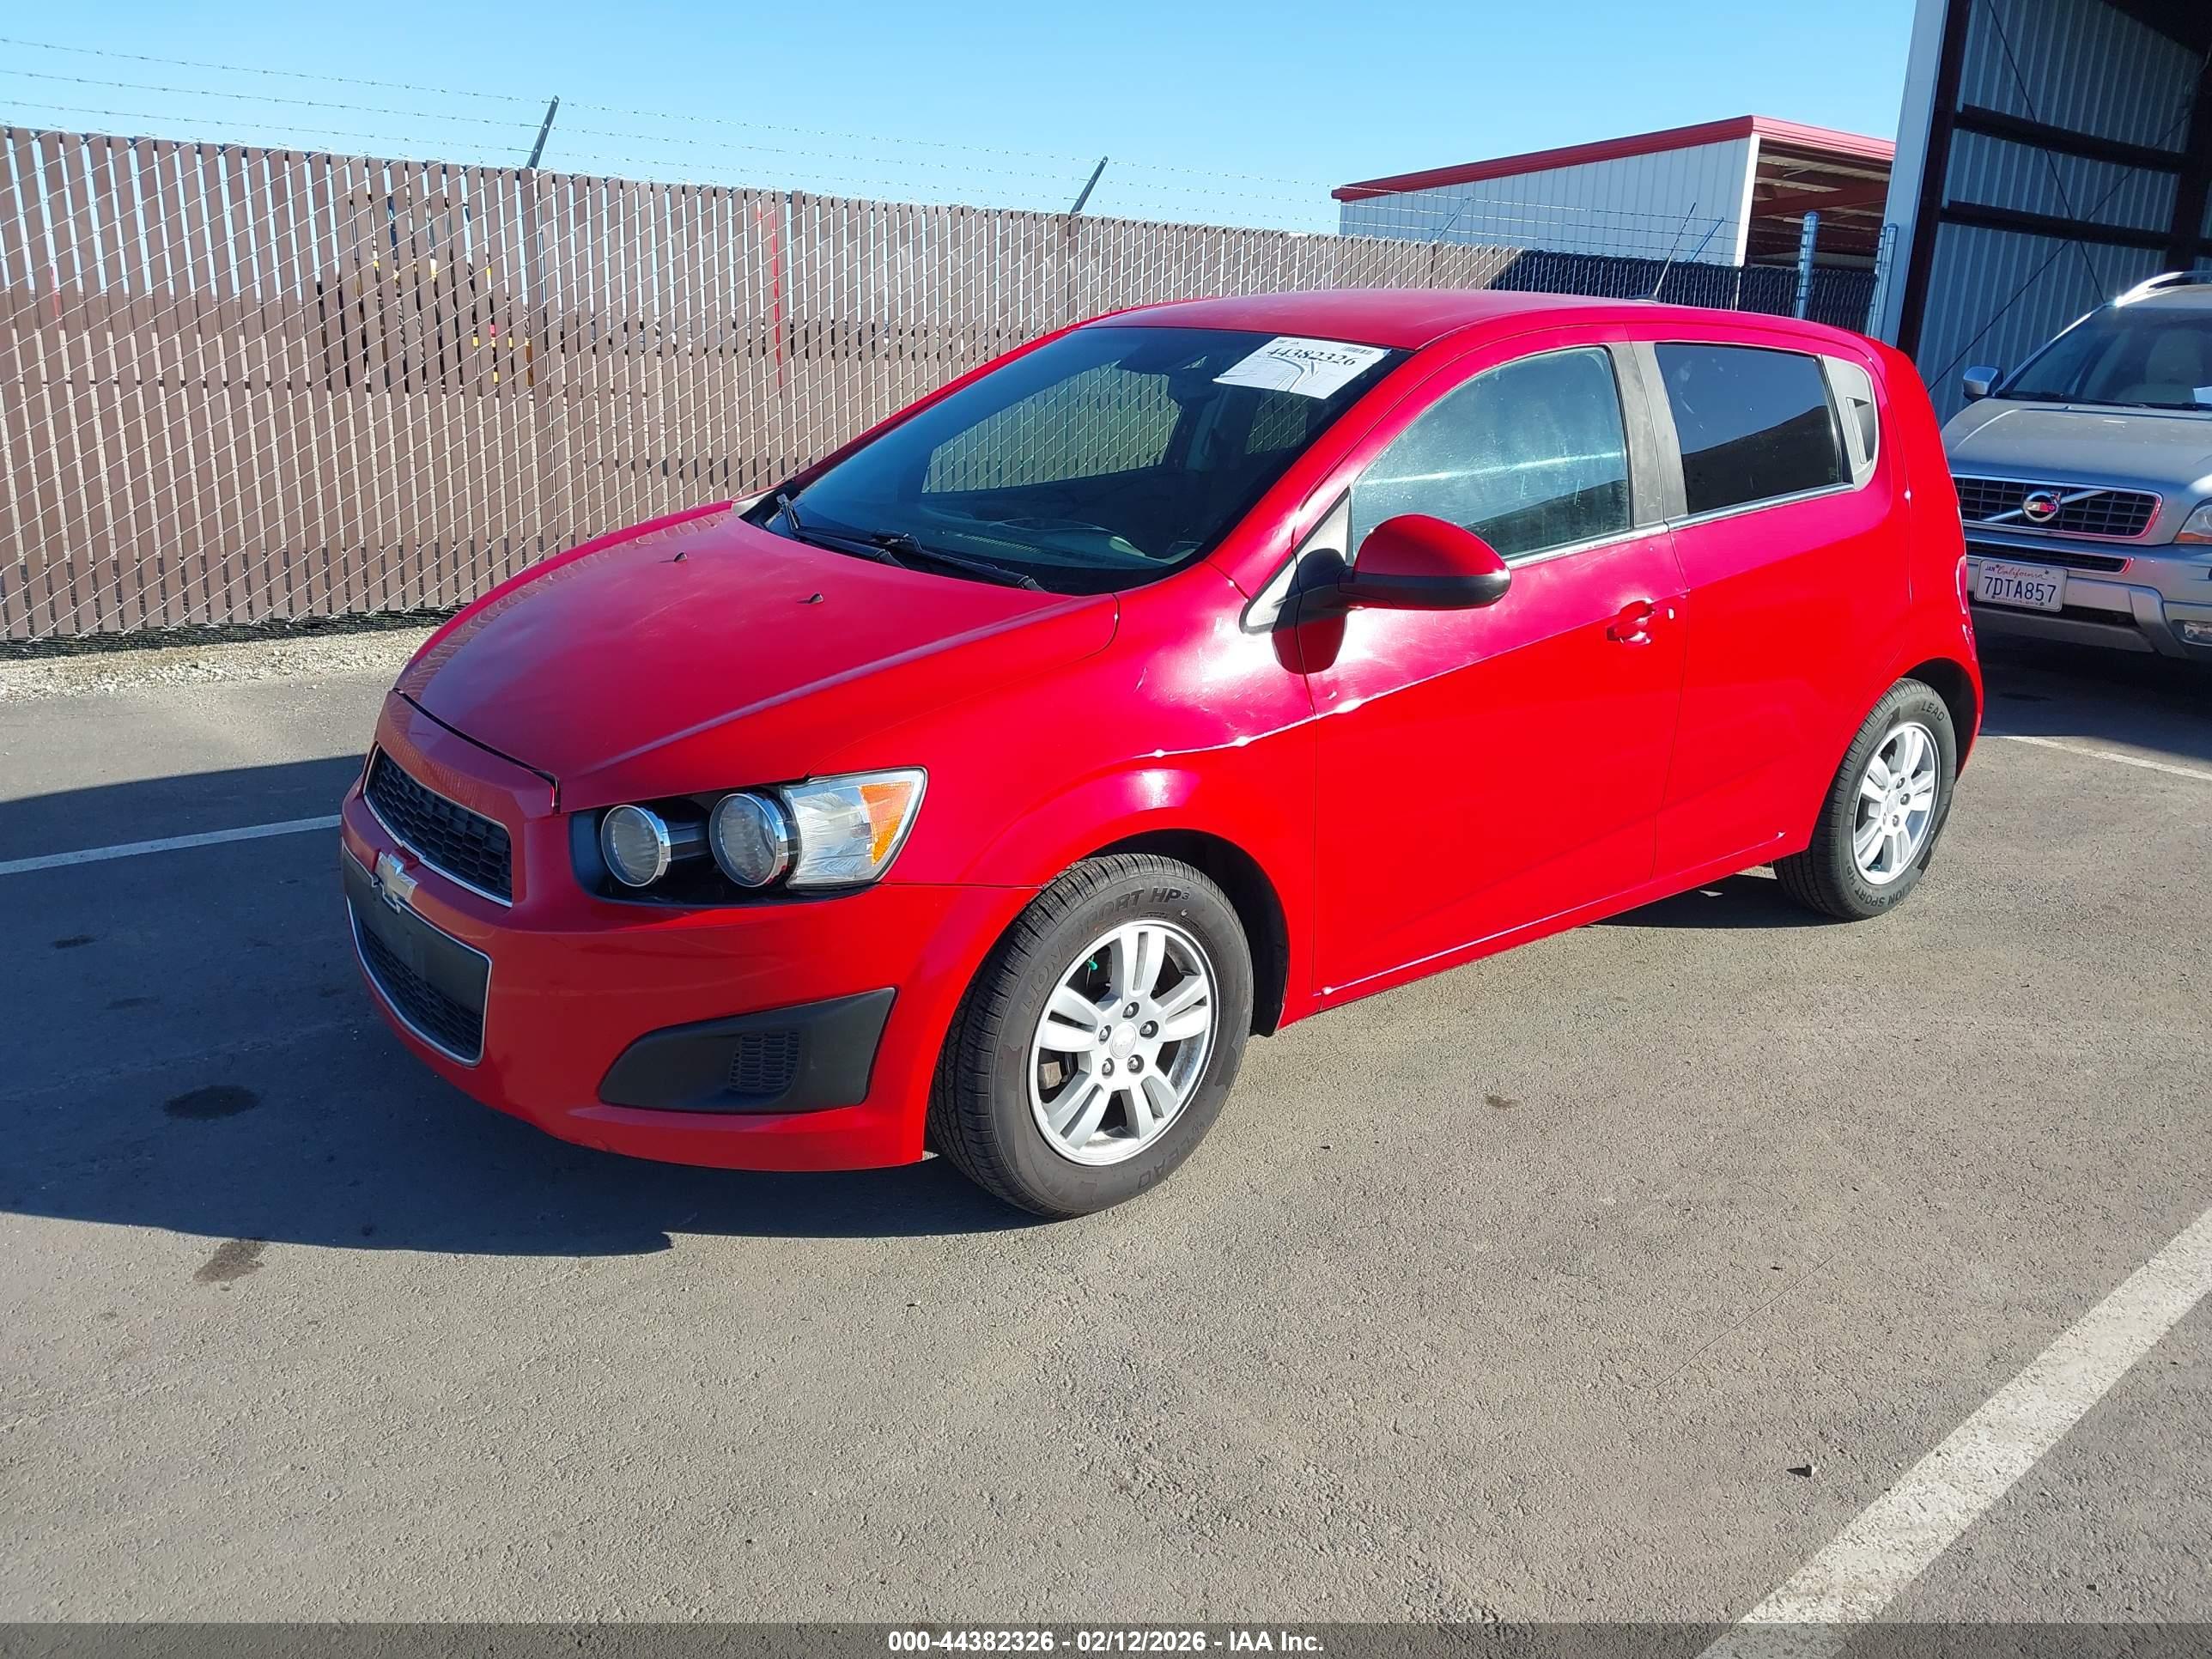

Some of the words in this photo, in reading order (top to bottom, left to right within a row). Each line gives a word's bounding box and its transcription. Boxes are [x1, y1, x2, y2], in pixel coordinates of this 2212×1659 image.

[1267, 346, 1357, 367] 44382326
[1996, 565, 2047, 580] California
[1984, 576, 2057, 603] 7DTA857
[1855, 886, 1886, 907] SPORT
